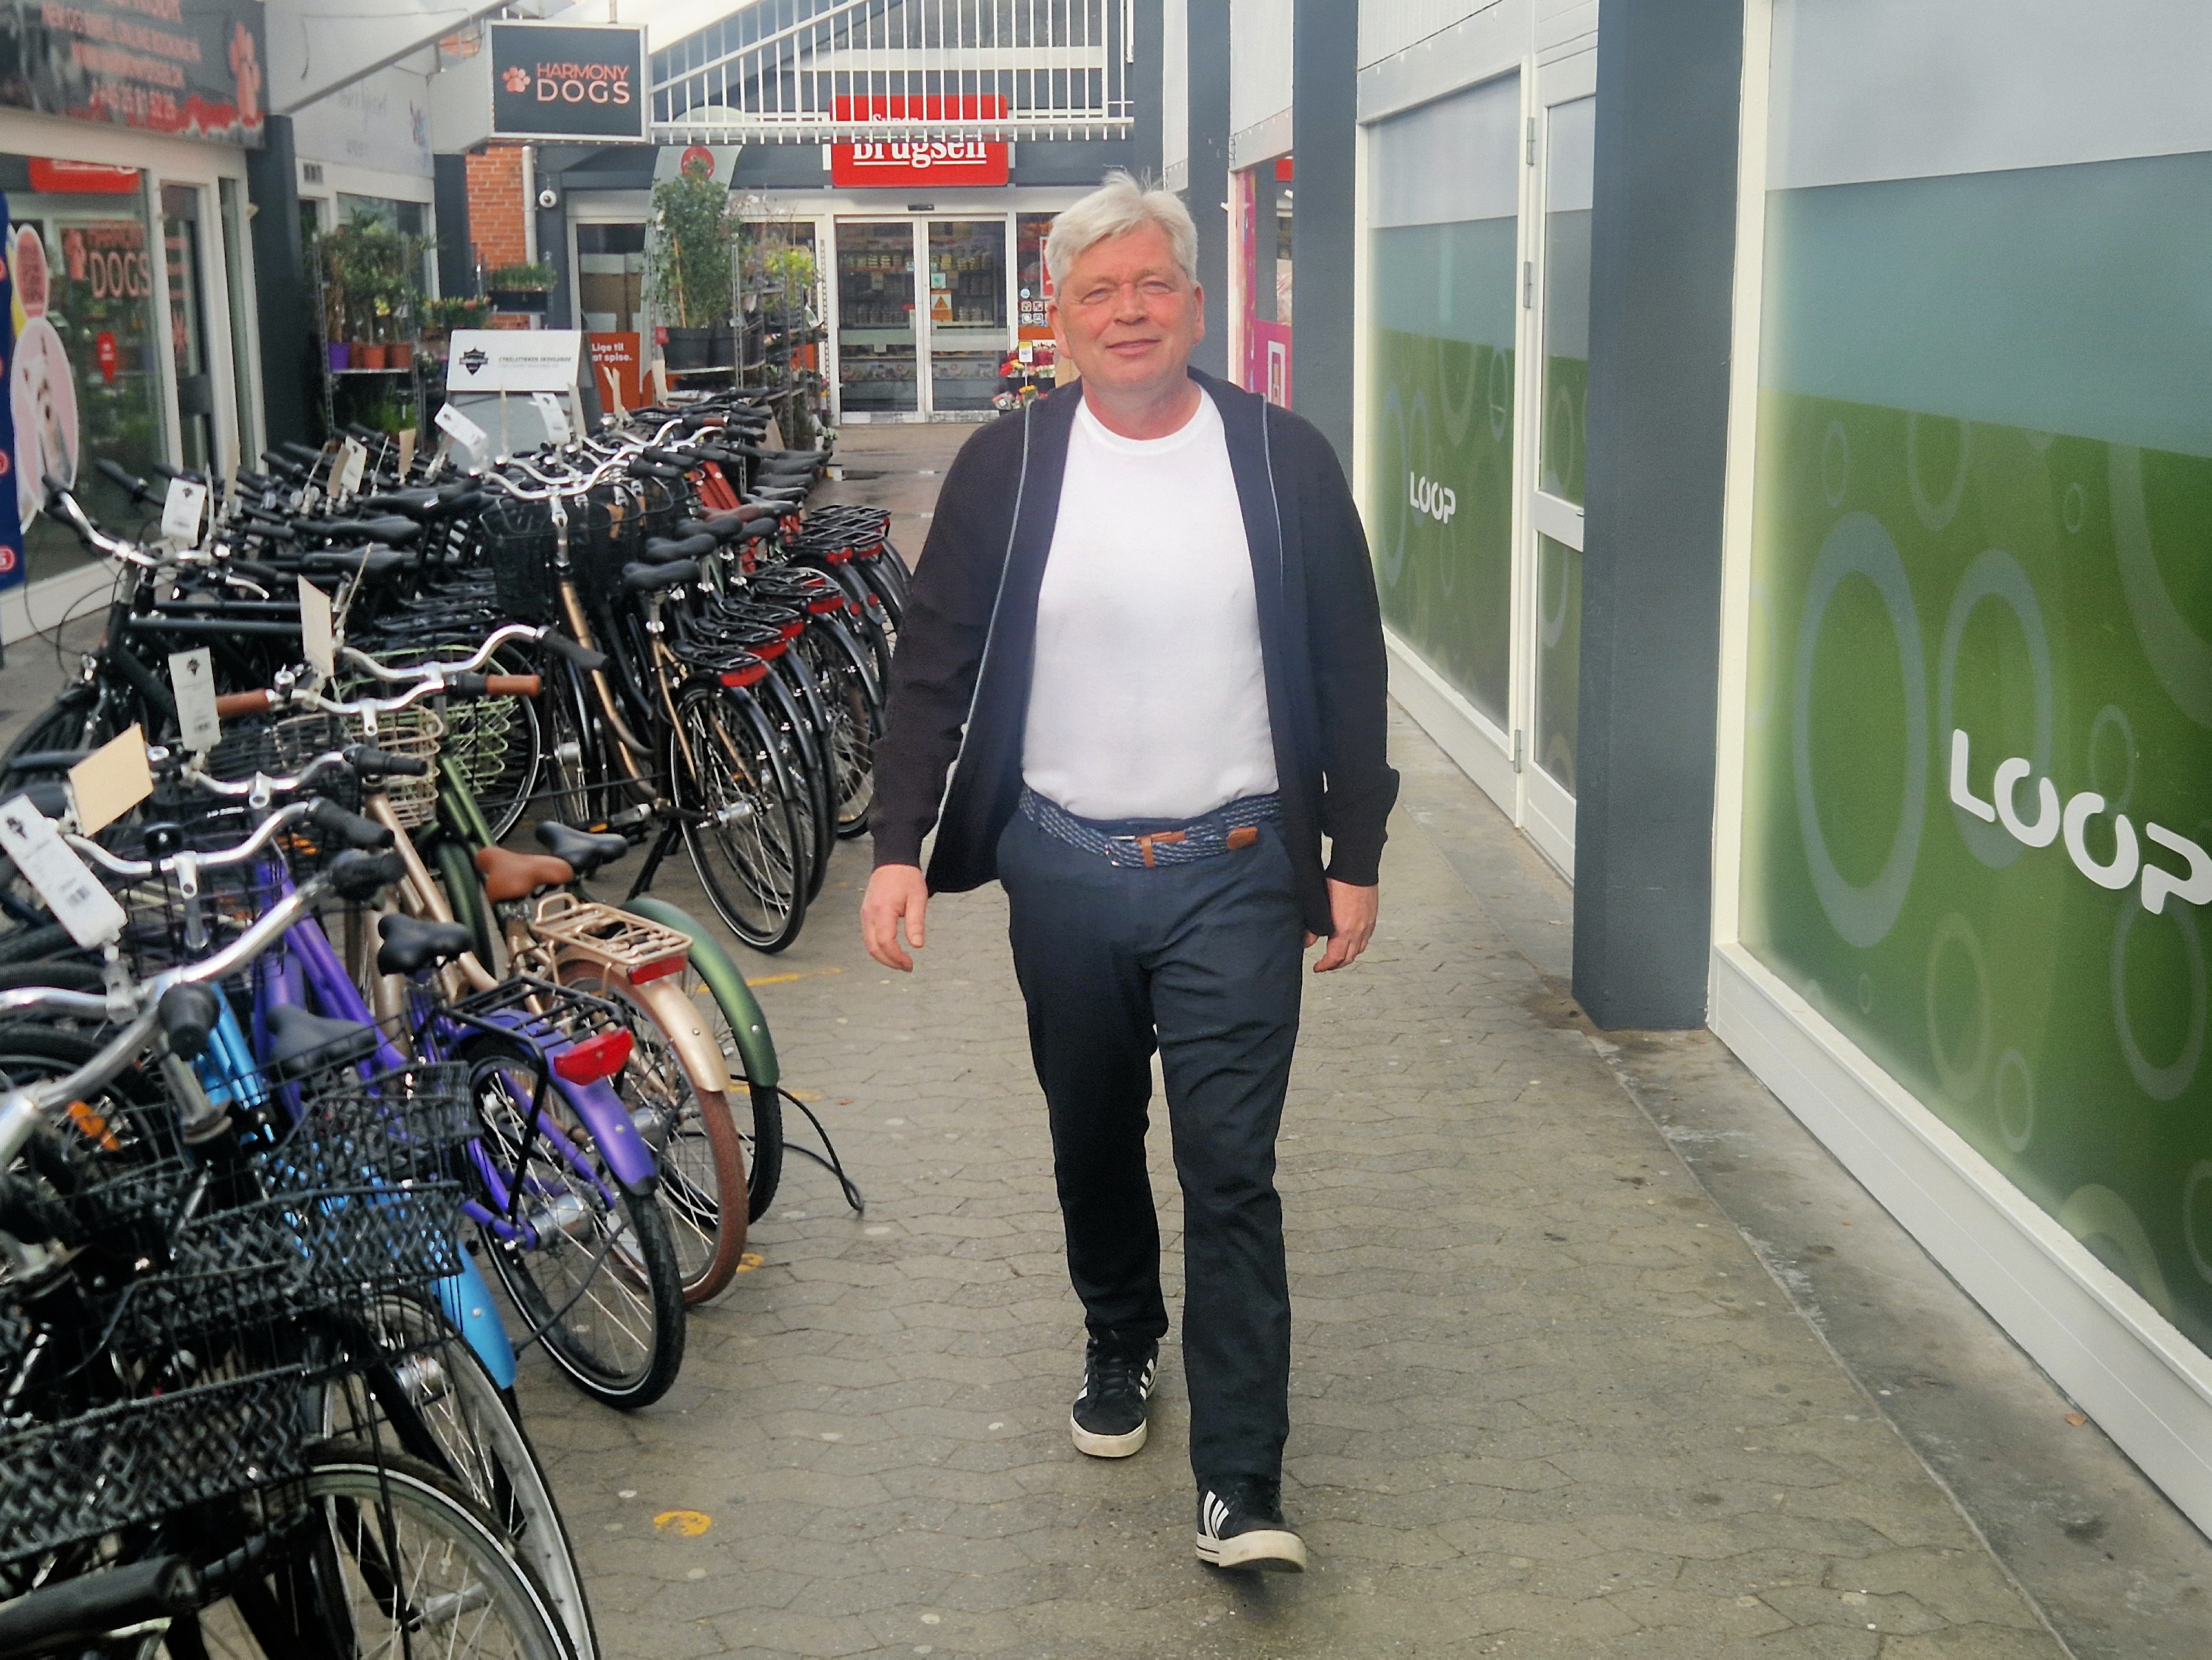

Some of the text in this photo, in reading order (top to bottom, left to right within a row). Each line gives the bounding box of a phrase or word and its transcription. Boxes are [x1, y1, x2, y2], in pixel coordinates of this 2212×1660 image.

[537, 63, 628, 80] HARMONY
[537, 78, 630, 104] DOGS
[89, 251, 153, 299] DOGS
[591, 341, 625, 353] Lige til
[592, 352, 633, 364] at spise.
[1410, 471, 1456, 524] LOOP
[1950, 729, 2212, 915] LOOP
